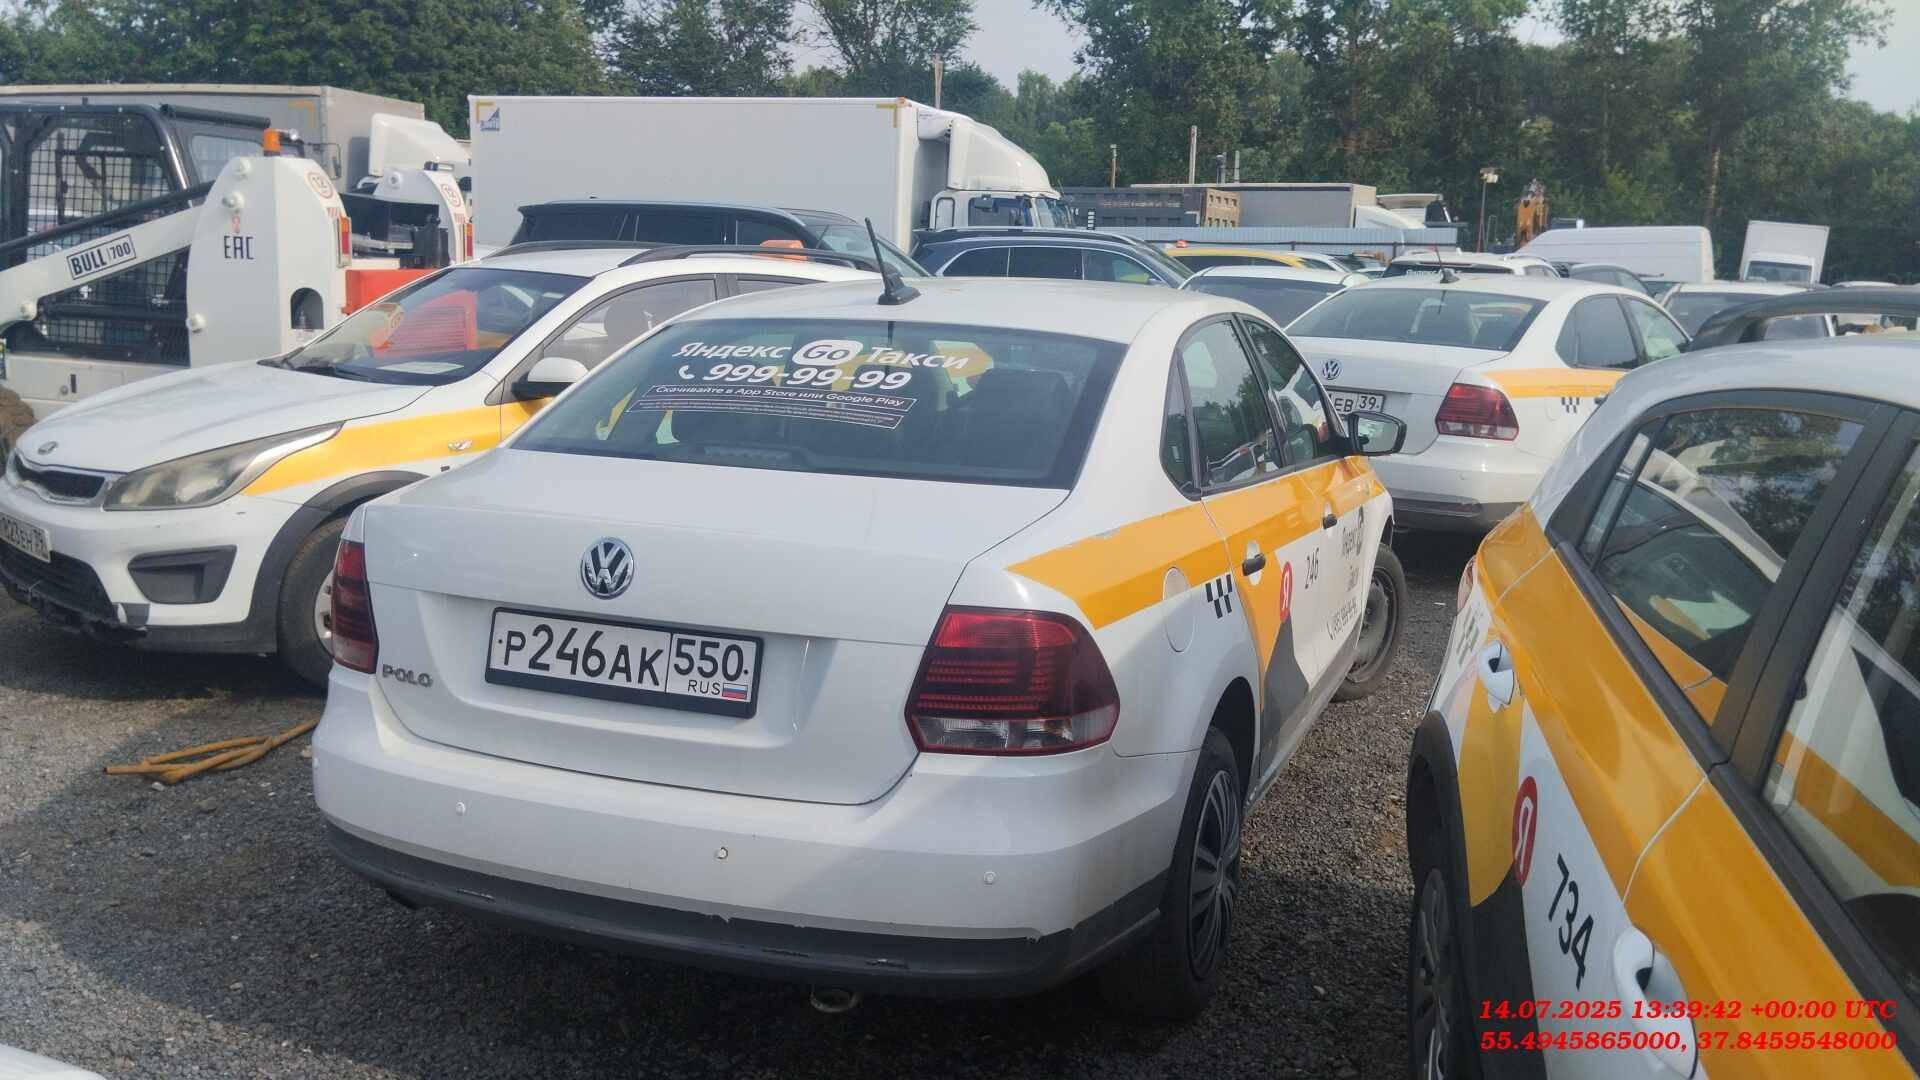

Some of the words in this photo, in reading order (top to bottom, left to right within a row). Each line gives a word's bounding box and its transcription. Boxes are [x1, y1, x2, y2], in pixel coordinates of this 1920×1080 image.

[71, 249, 107, 276] BULL
[110, 242, 132, 260] 700
[224, 235, 254, 260] EAC
[672, 342, 792, 359] Яндекс
[802, 343, 850, 360] Go
[864, 346, 970, 370] Такси
[703, 363, 911, 390] 999-99-99
[734, 387, 762, 398] App
[762, 389, 797, 398] Store
[826, 392, 873, 403] Google
[874, 397, 905, 407] Play
[1359, 395, 1377, 410] 39
[1305, 547, 1319, 590] 246
[504, 623, 665, 687] Р246АК
[672, 637, 745, 682] 550
[382, 663, 434, 688] POLO
[687, 679, 721, 696] RUS
[1548, 852, 1594, 991] 734
